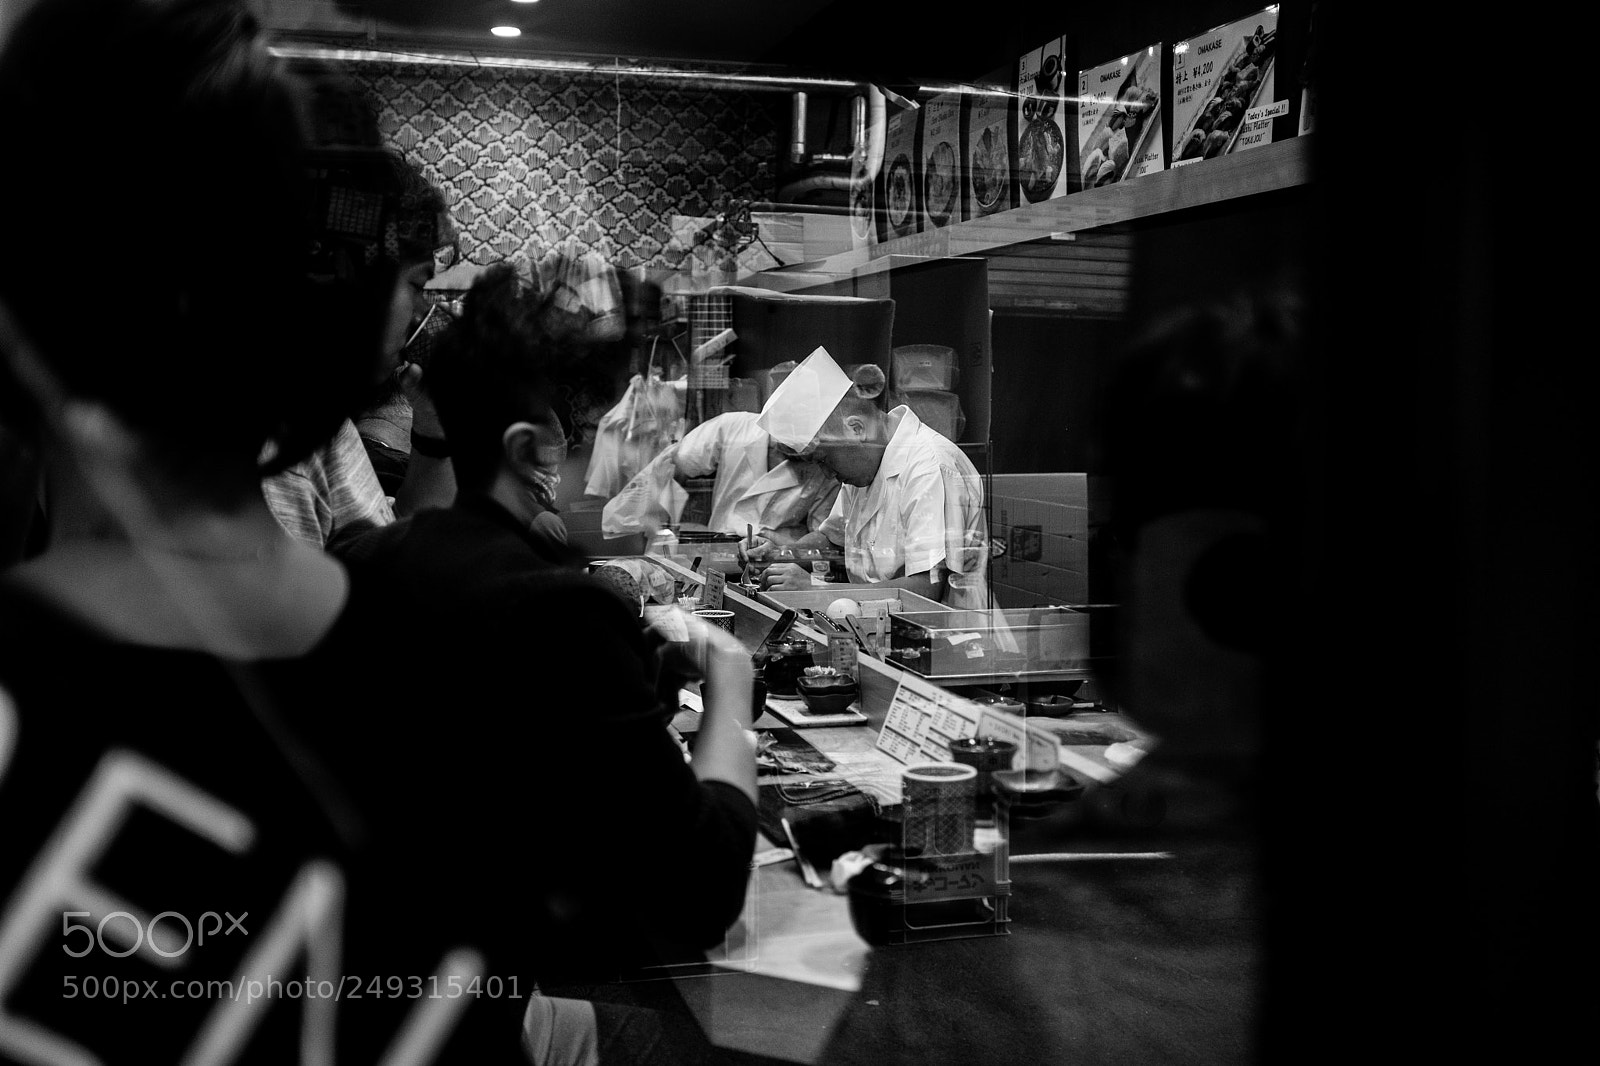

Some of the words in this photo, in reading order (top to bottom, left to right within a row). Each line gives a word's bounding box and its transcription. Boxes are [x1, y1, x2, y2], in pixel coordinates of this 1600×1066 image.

[1197, 38, 1222, 56] OMAKASE
[1099, 69, 1122, 83] OMAKASE
[1193, 61, 1214, 79] ¥4,200
[1081, 80, 1086, 91] 2
[1247, 109, 1264, 121] Today's
[1265, 104, 1280, 117] Special
[1253, 120, 1270, 132] Platter
[1145, 152, 1159, 163] Platter
